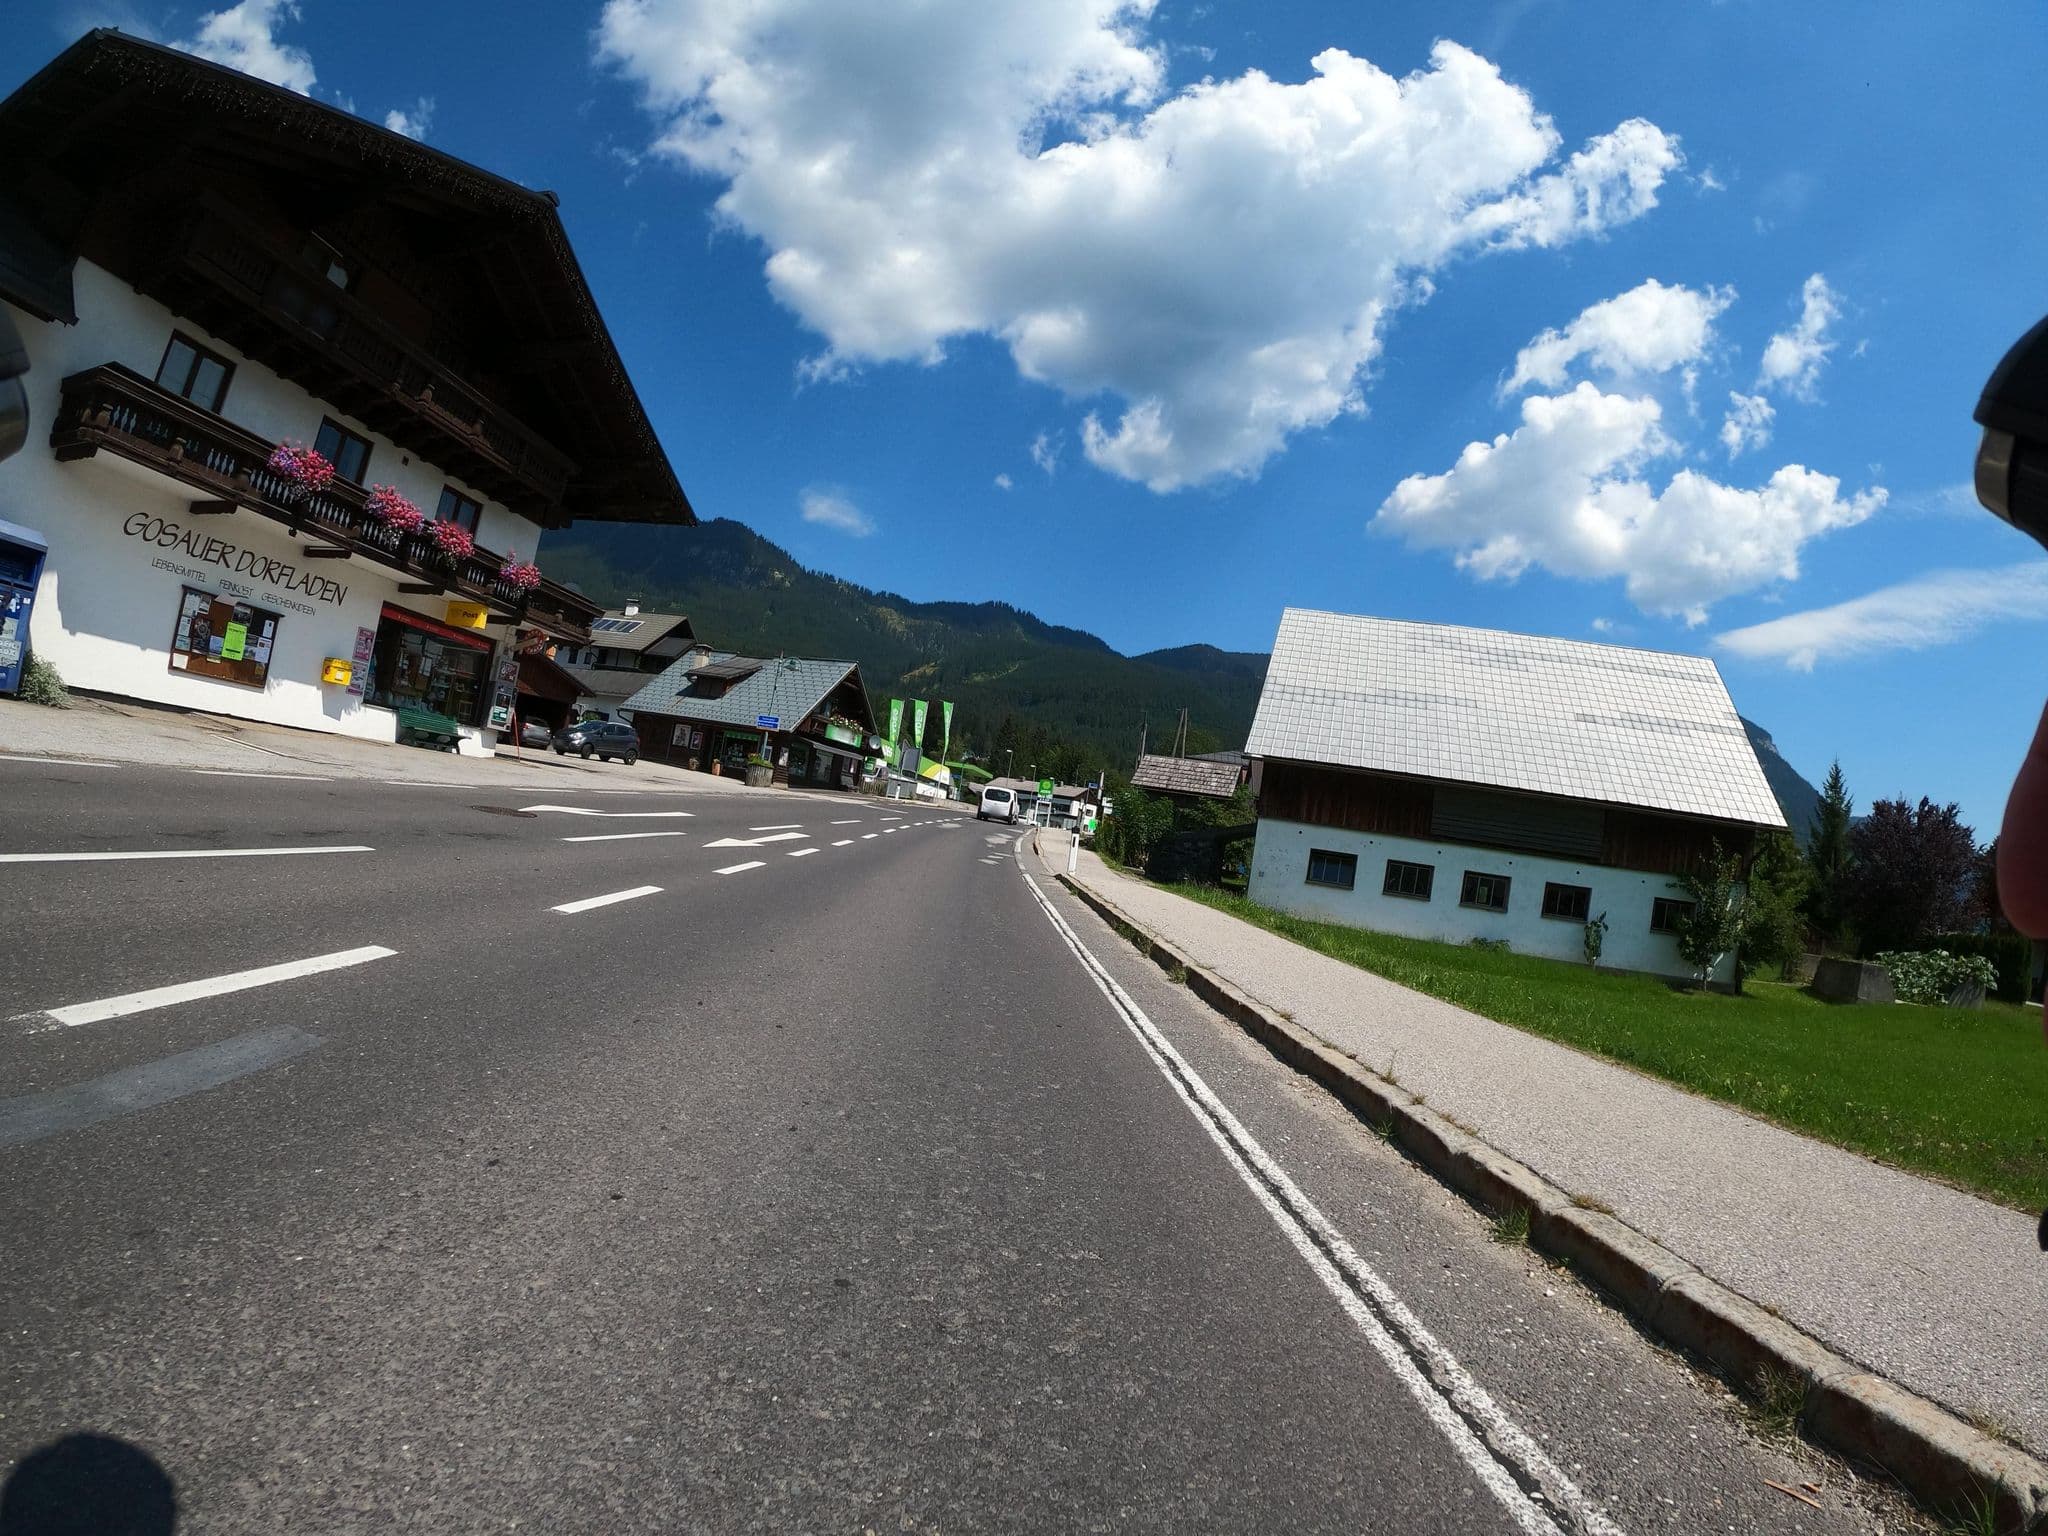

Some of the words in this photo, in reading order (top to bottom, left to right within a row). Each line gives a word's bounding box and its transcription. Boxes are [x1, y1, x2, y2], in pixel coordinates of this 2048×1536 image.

[123, 512, 236, 569] GOSAUER
[235, 549, 348, 607] DORFLADEN
[151, 558, 206, 583] LEBENSMITTEL
[219, 579, 254, 597] FEINKOST
[261, 592, 316, 617] GESCHENKIDEEN
